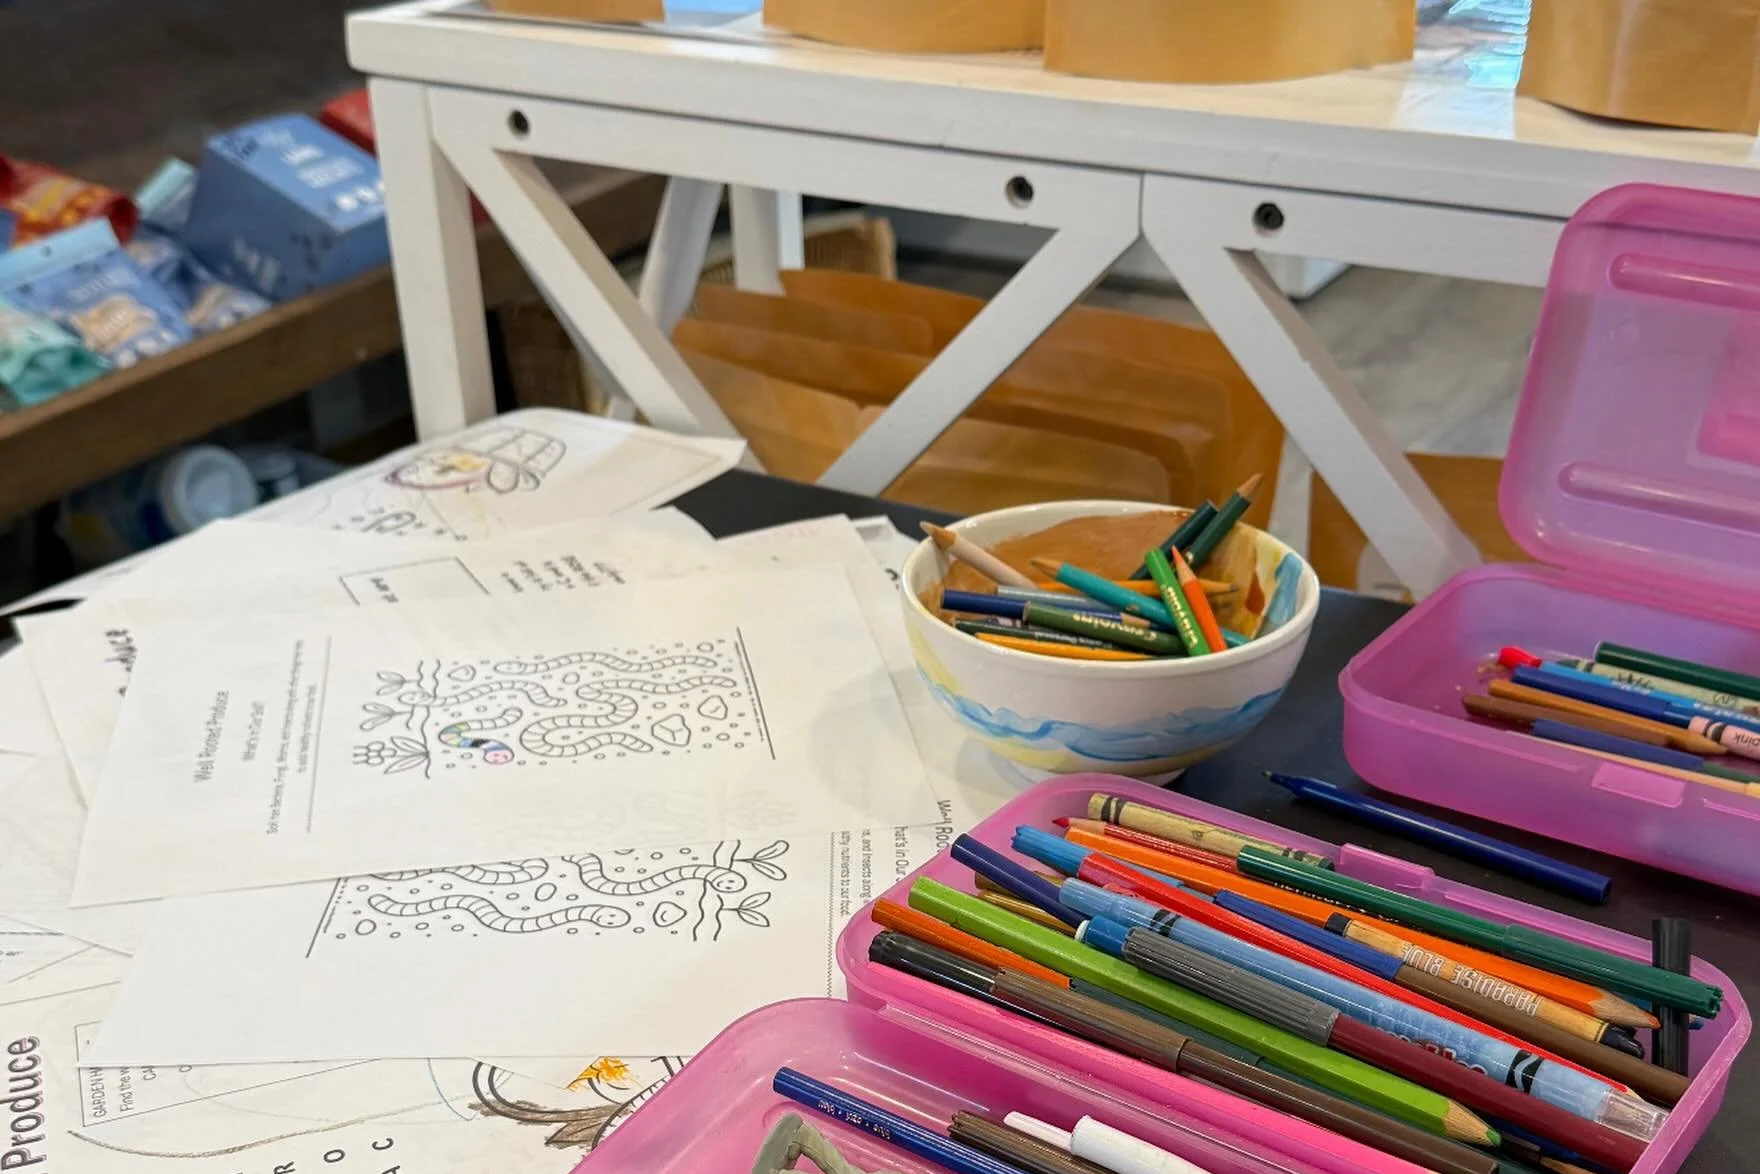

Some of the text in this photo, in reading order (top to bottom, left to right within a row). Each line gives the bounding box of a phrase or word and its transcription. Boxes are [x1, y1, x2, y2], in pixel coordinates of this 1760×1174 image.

[1400, 943, 1543, 1017] PARADISE BLUE
[0, 1035, 47, 1171] Produce
[90, 1078, 108, 1118] GARDEN
[119, 1075, 132, 1091] the
[119, 1091, 135, 1112] Find
